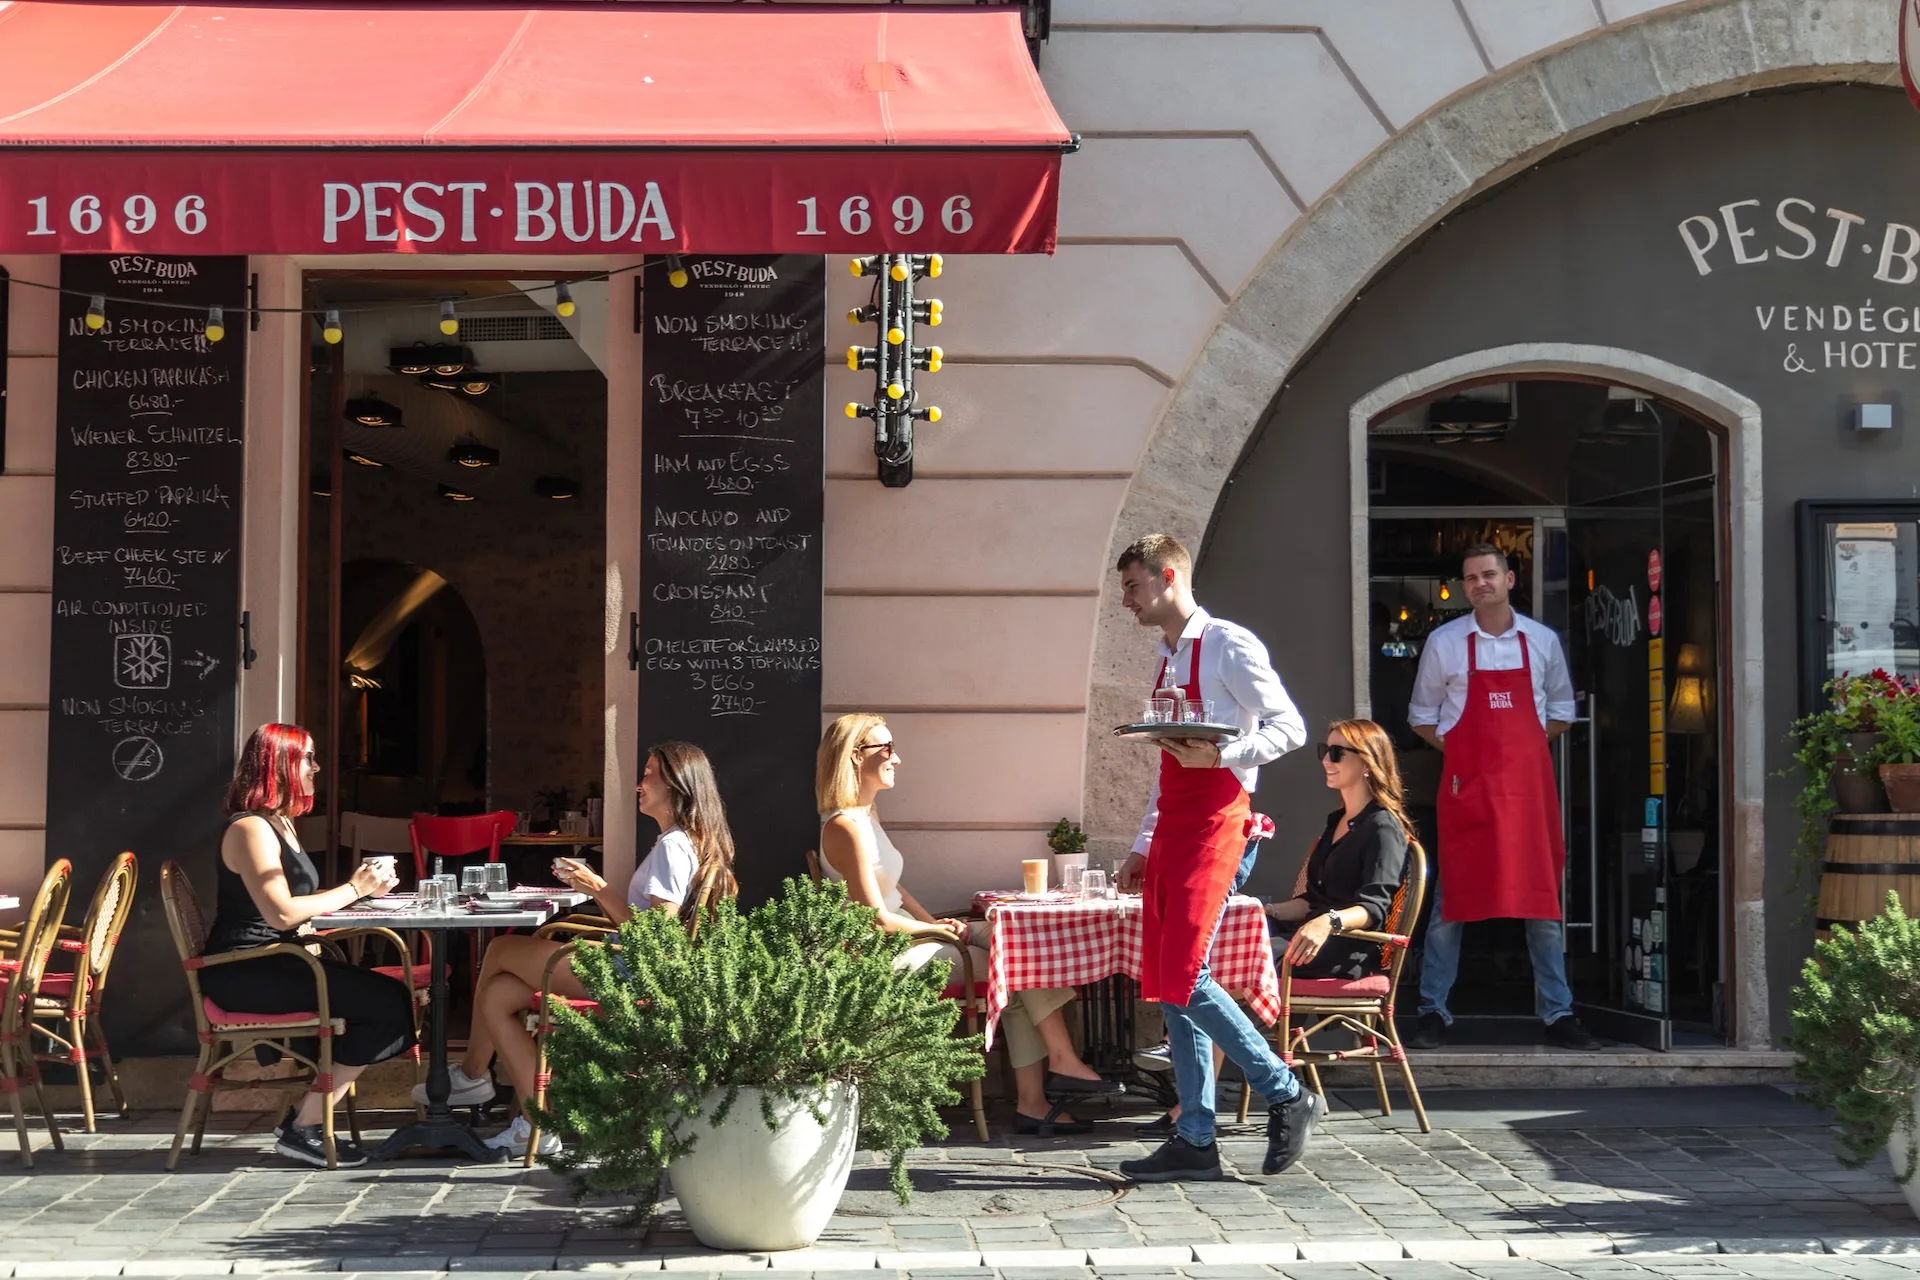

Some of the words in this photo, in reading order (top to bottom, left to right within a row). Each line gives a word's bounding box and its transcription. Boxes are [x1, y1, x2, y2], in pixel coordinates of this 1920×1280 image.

[27, 195, 207, 235] 1696
[796, 195, 973, 235] 1696
[119, 318, 205, 335] SMOKIN
[655, 315, 698, 335] NON
[704, 312, 807, 334] SMOKING
[1783, 343, 1816, 373] &
[73, 369, 148, 389] CHICKEN
[650, 373, 799, 403] BREAKFAST
[71, 423, 143, 446] WIENER
[147, 424, 242, 445] SCHNITZEL
[654, 453, 691, 473] HAM
[70, 489, 149, 509] STUFFED
[655, 505, 738, 528] AVOCADO
[755, 507, 791, 523] AND
[647, 532, 726, 552] TOMATOES
[729, 536, 753, 550] ON
[755, 534, 812, 551] TOAST
[57, 546, 111, 565] BEEF
[114, 547, 168, 564] CHEEK
[652, 583, 774, 603] CROISSANT
[56, 600, 88, 616] AIR
[92, 601, 208, 617] CONDITIONED
[645, 637, 730, 655] OMELETTE
[728, 642, 749, 652] OR
[747, 635, 820, 653] SCRAMBLED
[646, 657, 681, 670] EGG
[687, 658, 729, 670] WITH
[732, 655, 744, 670] 3
[746, 655, 821, 671] TOPPINGS
[690, 672, 707, 690] 3
[711, 674, 755, 691] EGG
[1488, 691, 1511, 701] PEST
[1490, 700, 1513, 709] BUDA
[61, 698, 100, 716] NON
[108, 696, 205, 718] SMOKING
[99, 719, 193, 735] TERRACE
